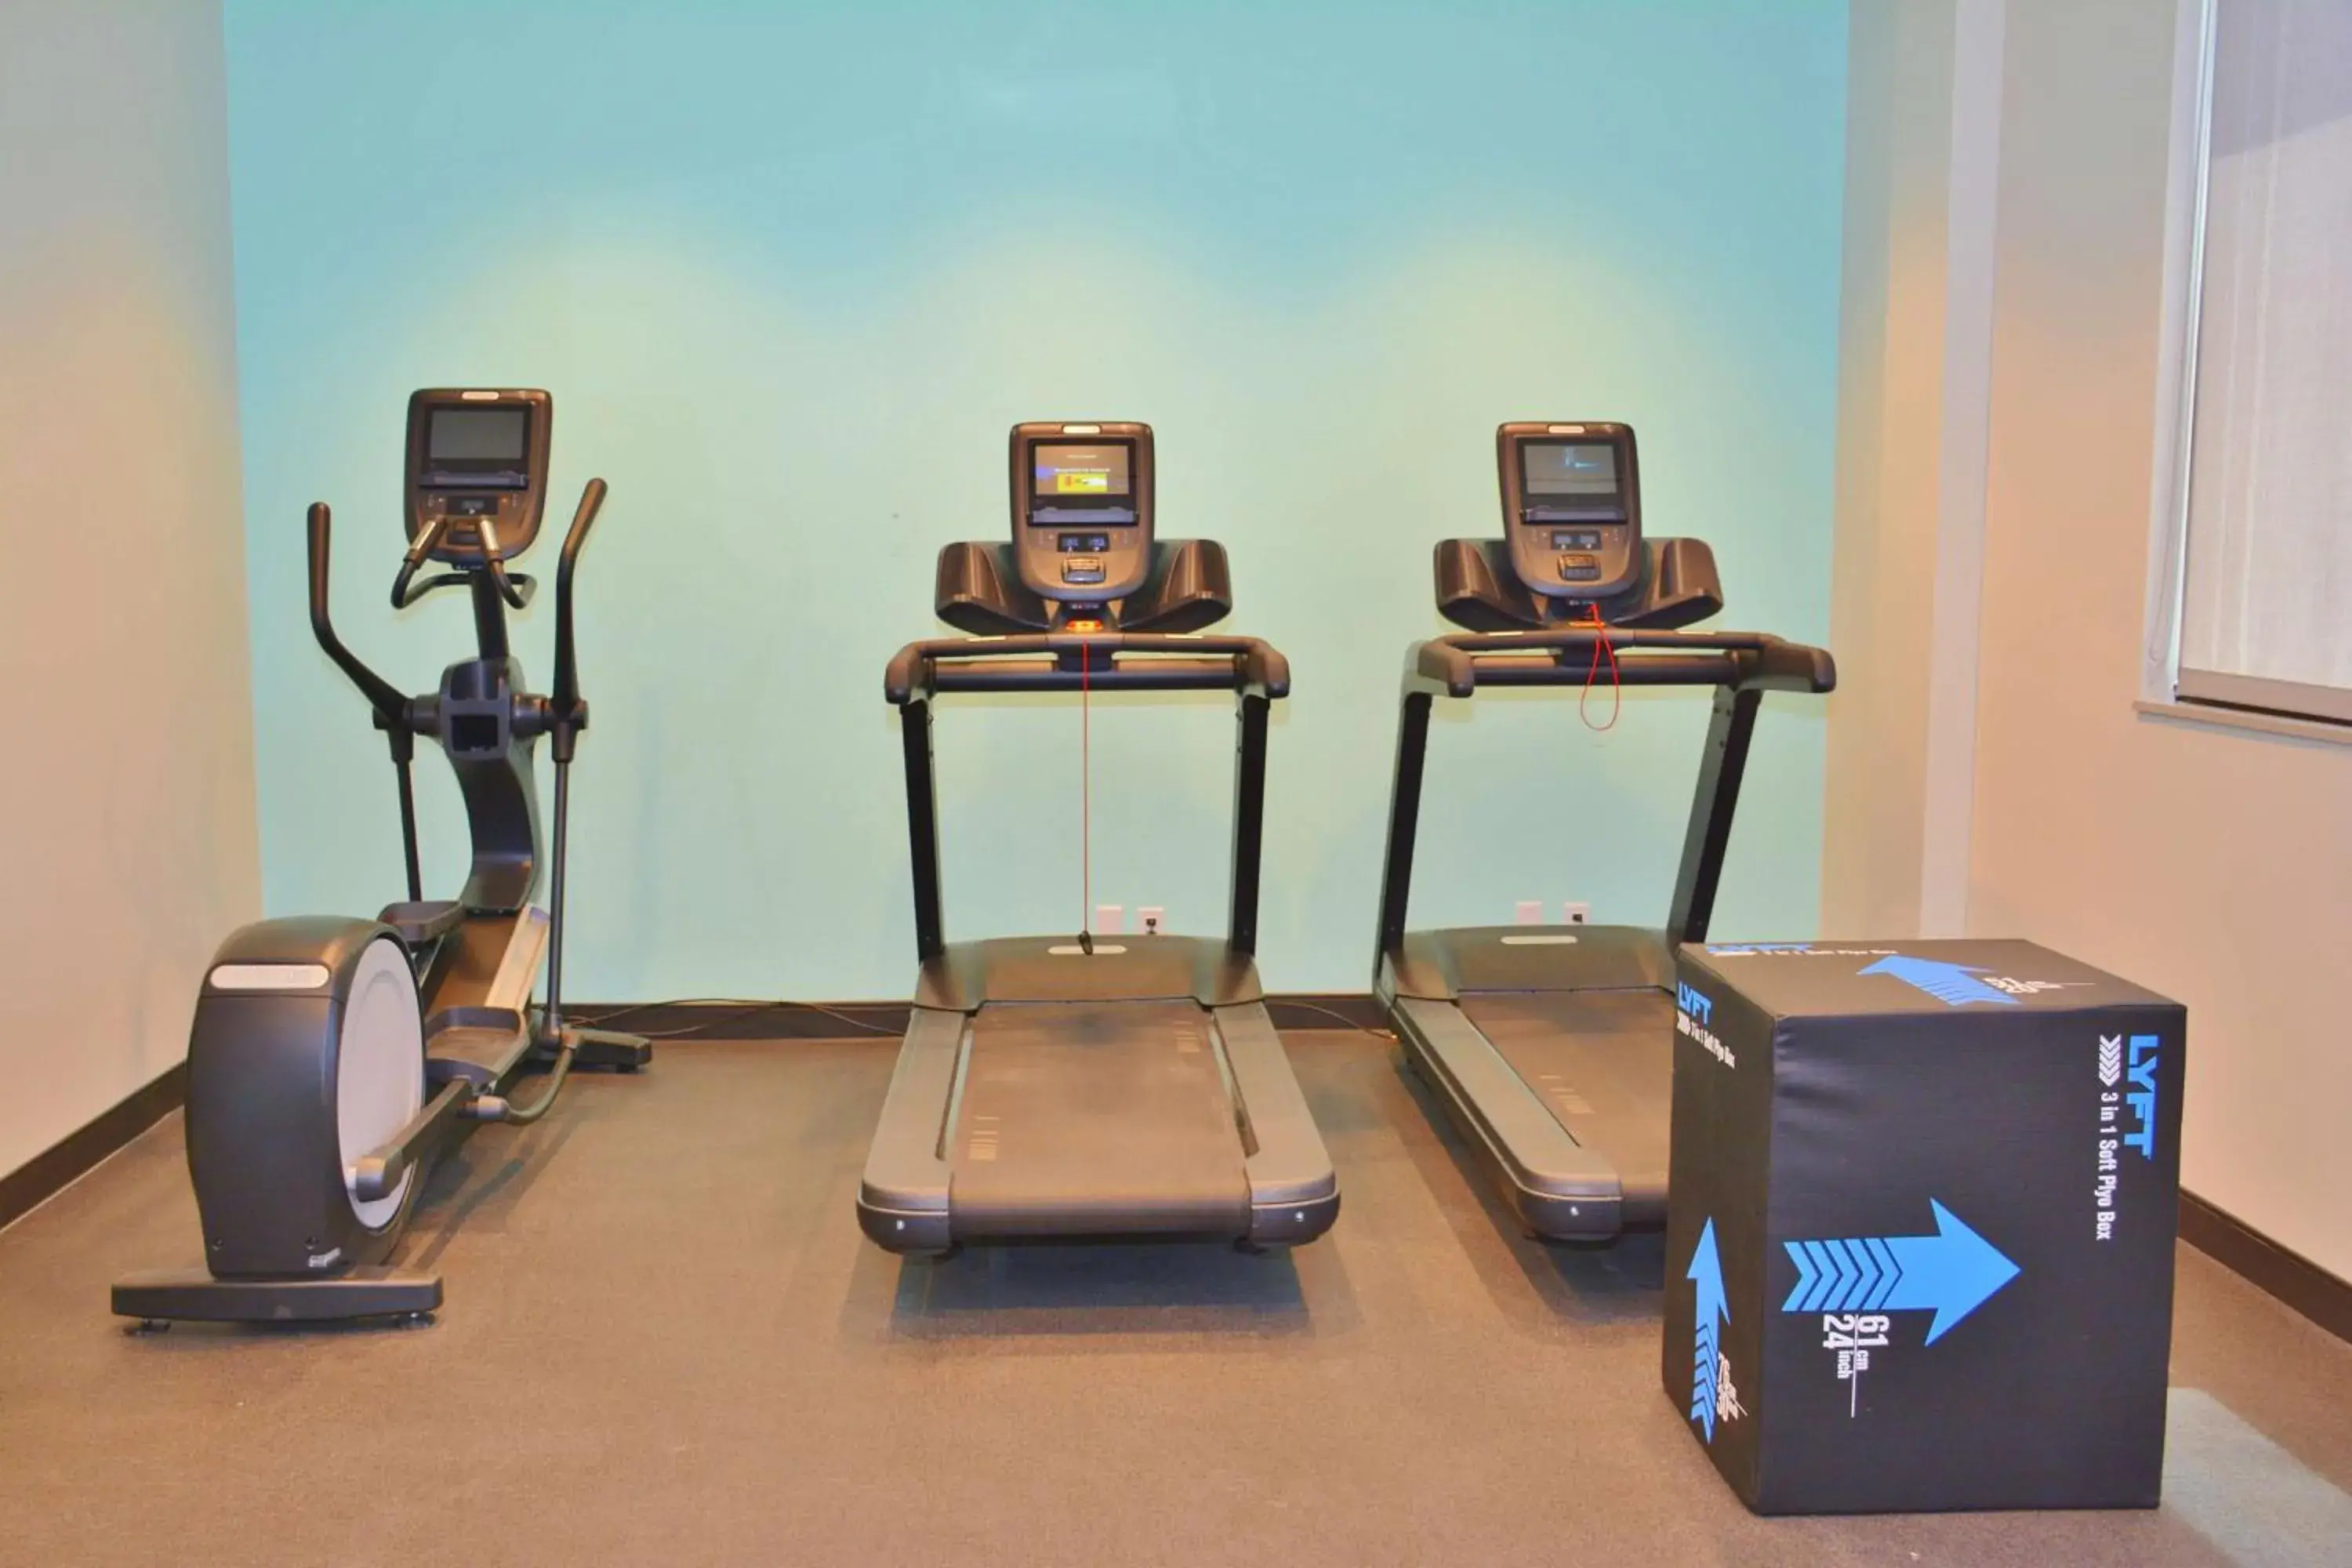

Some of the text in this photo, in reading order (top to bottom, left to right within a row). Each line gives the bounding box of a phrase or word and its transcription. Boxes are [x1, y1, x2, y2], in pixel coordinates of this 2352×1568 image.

[1678, 980, 1712, 1025] LYFT
[2124, 1035, 2158, 1159] LYFT
[2094, 1092, 2119, 1241] 3 in 1 Soft Plyo Box
[1822, 1314, 1855, 1379] 24 inch
[1855, 1315, 1890, 1371] 61 cm
